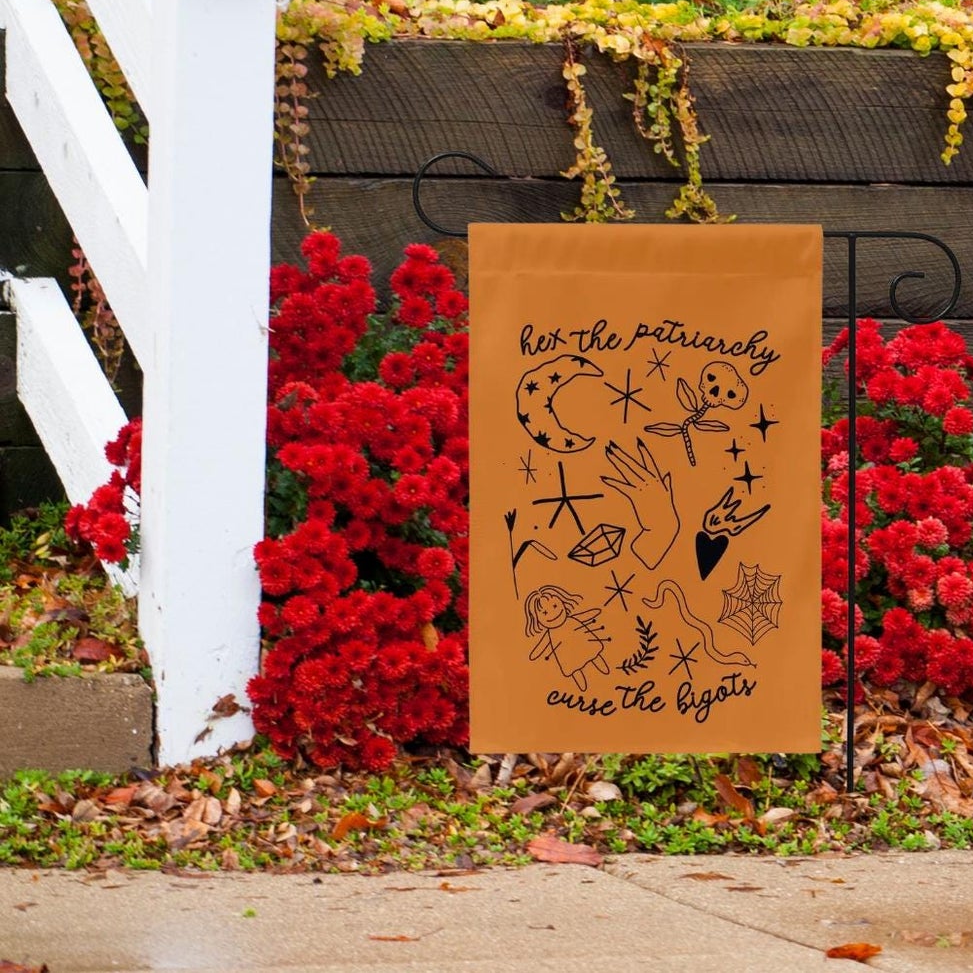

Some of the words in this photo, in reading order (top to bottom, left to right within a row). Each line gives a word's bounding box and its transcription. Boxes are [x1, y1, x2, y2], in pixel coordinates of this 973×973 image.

[520, 324, 567, 356] hex
[569, 319, 622, 353] the
[623, 319, 781, 377] patriarchy
[547, 689, 617, 717] curse
[615, 680, 666, 712] the
[676, 672, 757, 724] bigots
